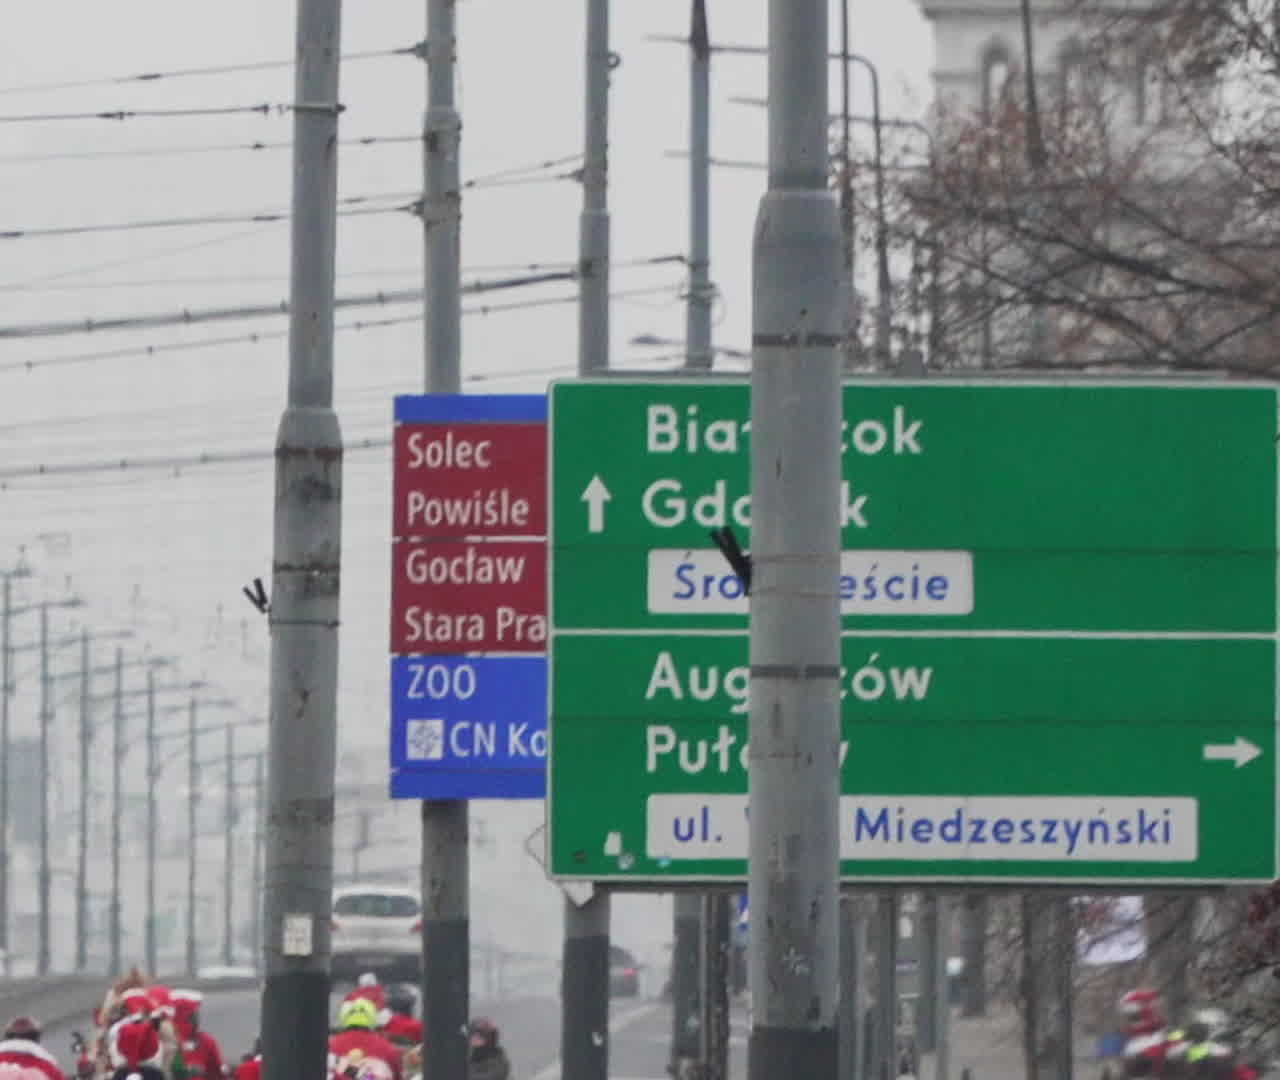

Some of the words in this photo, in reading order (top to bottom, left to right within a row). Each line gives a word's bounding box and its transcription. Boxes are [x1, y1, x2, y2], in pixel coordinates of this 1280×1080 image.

[647, 404, 923, 454] Biaok
[407, 431, 492, 469] Solec
[407, 488, 530, 526] Powiśle
[406, 547, 527, 584] Gocław
[405, 606, 485, 642] Stara
[407, 664, 477, 700] ZOO
[645, 652, 934, 713] Augów
[450, 721, 496, 757] CN
[673, 806, 723, 843] ul.
[855, 807, 1174, 856] Miedzeszyński
